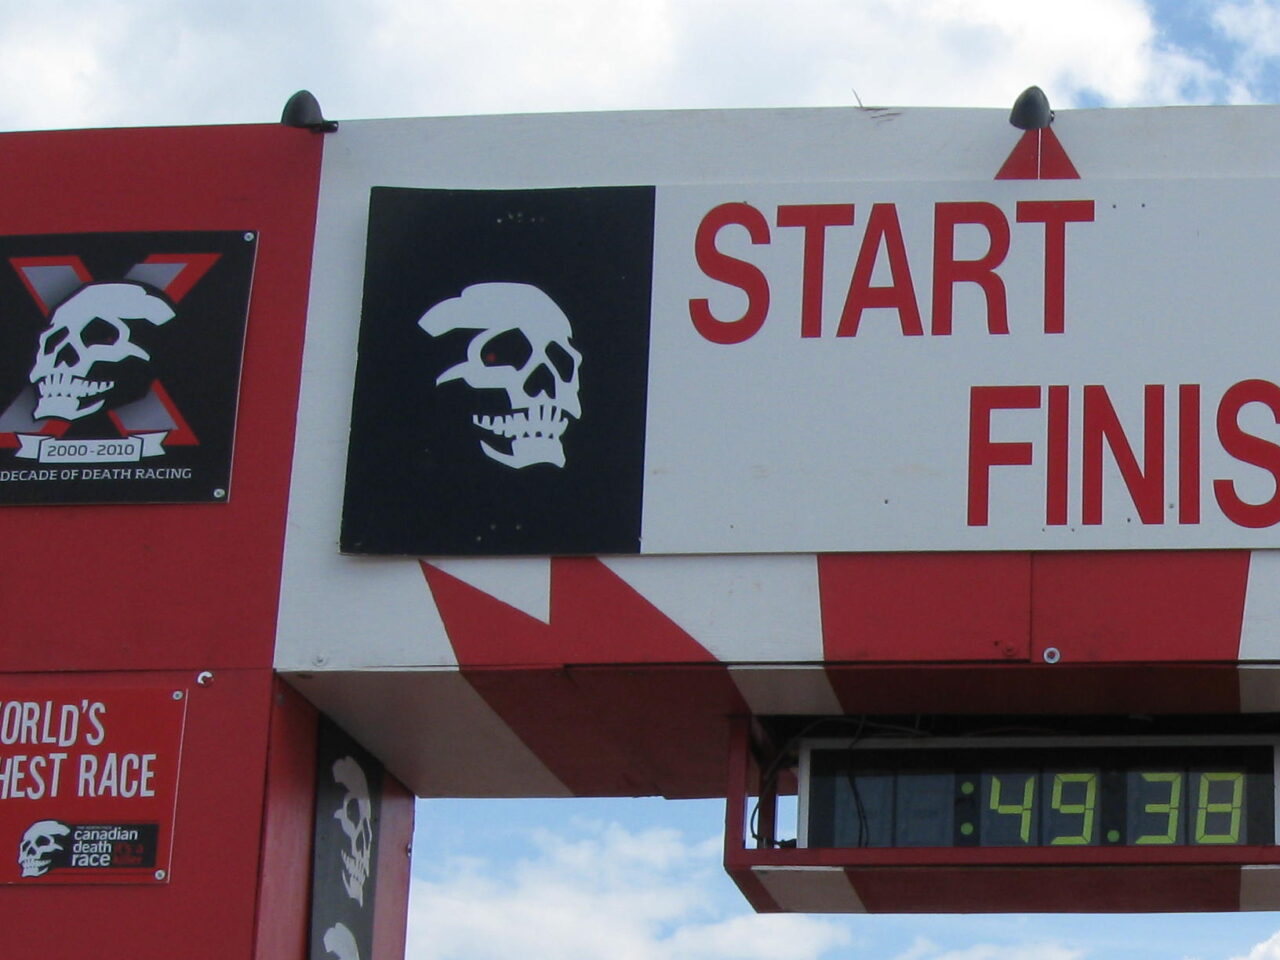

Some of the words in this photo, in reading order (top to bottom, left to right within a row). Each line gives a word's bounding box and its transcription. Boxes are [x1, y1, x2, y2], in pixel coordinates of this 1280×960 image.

[688, 199, 1095, 345] START
[0, 469, 58, 481] DECADE
[61, 468, 79, 481] OF
[82, 468, 133, 481] DEATH
[135, 467, 192, 480] RACING
[0, 699, 107, 747] ORLD'S
[77, 752, 157, 799] RACE
[74, 826, 138, 842] canadian
[73, 841, 112, 854] death
[71, 853, 111, 867] race
